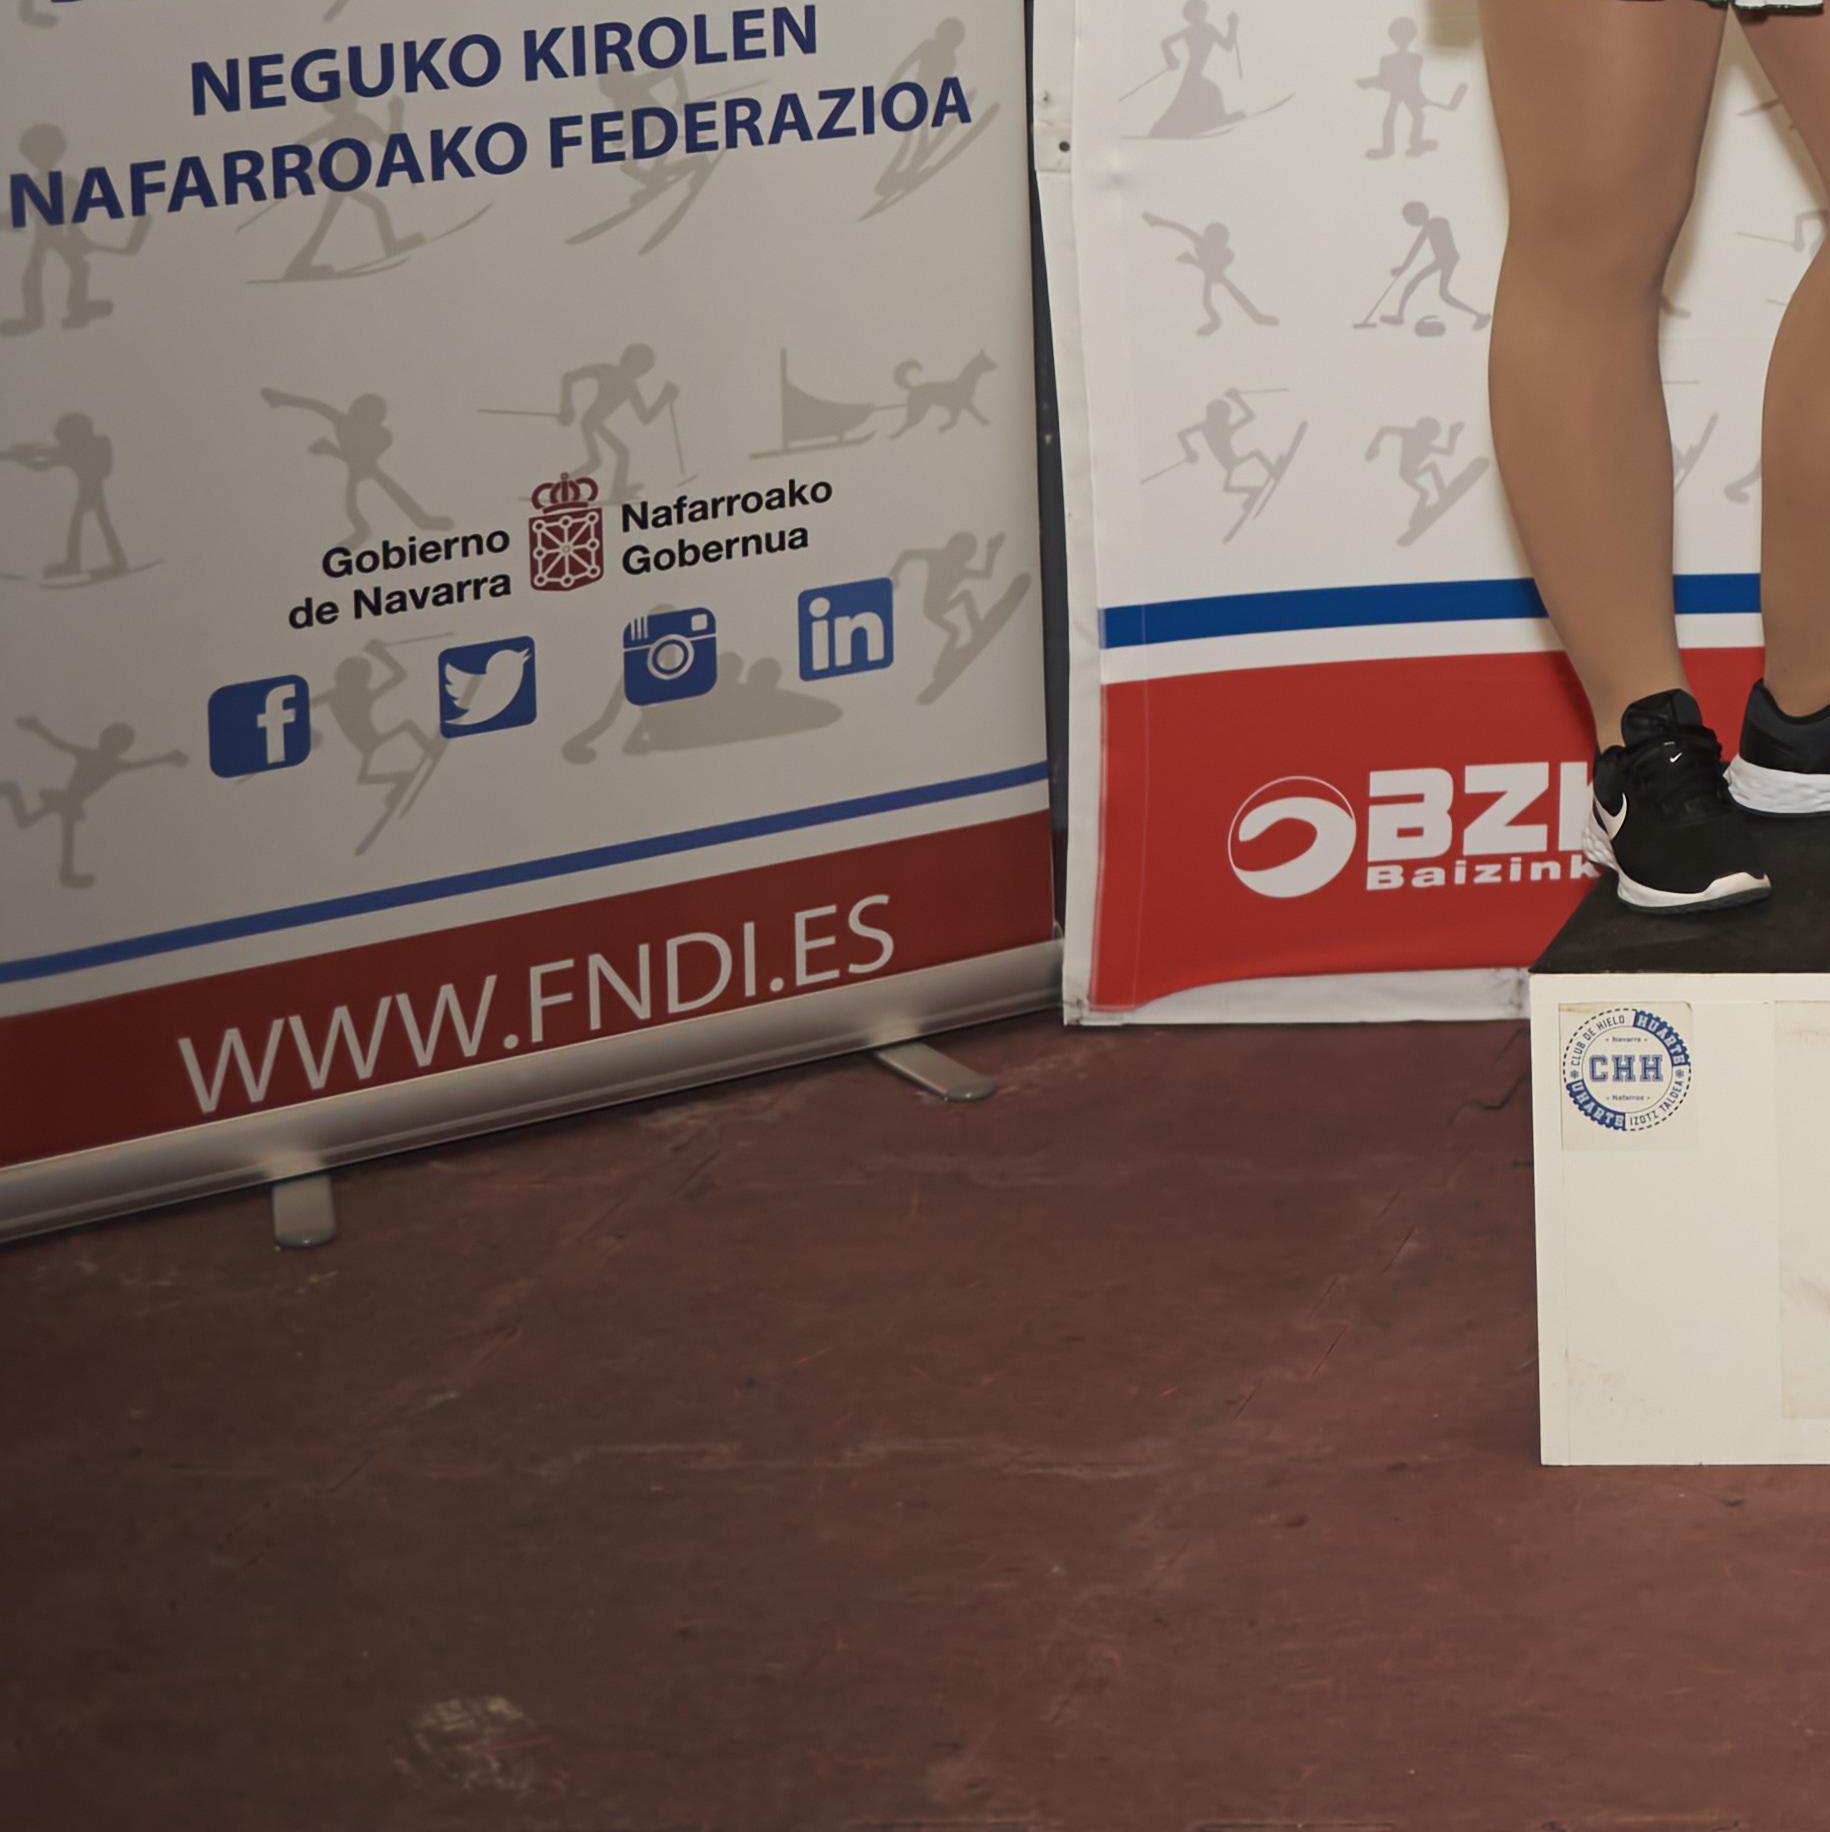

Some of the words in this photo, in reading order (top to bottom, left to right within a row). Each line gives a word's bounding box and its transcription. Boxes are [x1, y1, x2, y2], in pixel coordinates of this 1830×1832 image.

[191, 33, 500, 117] NEGUKO
[523, 4, 817, 82] KIROLEN
[8, 122, 528, 228] NAFARROAKO
[550, 76, 972, 168] FEDERAZIOA
[621, 478, 833, 533] Nafarroako
[322, 528, 510, 579] Gobierno
[622, 525, 809, 576] Gobernua
[288, 597, 340, 630] de
[354, 571, 512, 621] Navarra
[1366, 855, 1600, 890] Baizink
[177, 894, 895, 1114] WWW.FNDI.ES
[1571, 1041, 1586, 1066] CLUB
[1582, 1028, 1596, 1040] DE
[1596, 1015, 1625, 1030] HIELO
[1636, 1014, 1686, 1064] HUARTE
[1589, 1055, 1664, 1082] CHH
[1572, 1081, 1624, 1127] UHARTE
[1630, 1110, 1658, 1126] IZOTZ
[1659, 1080, 1683, 1112] TALDEA
